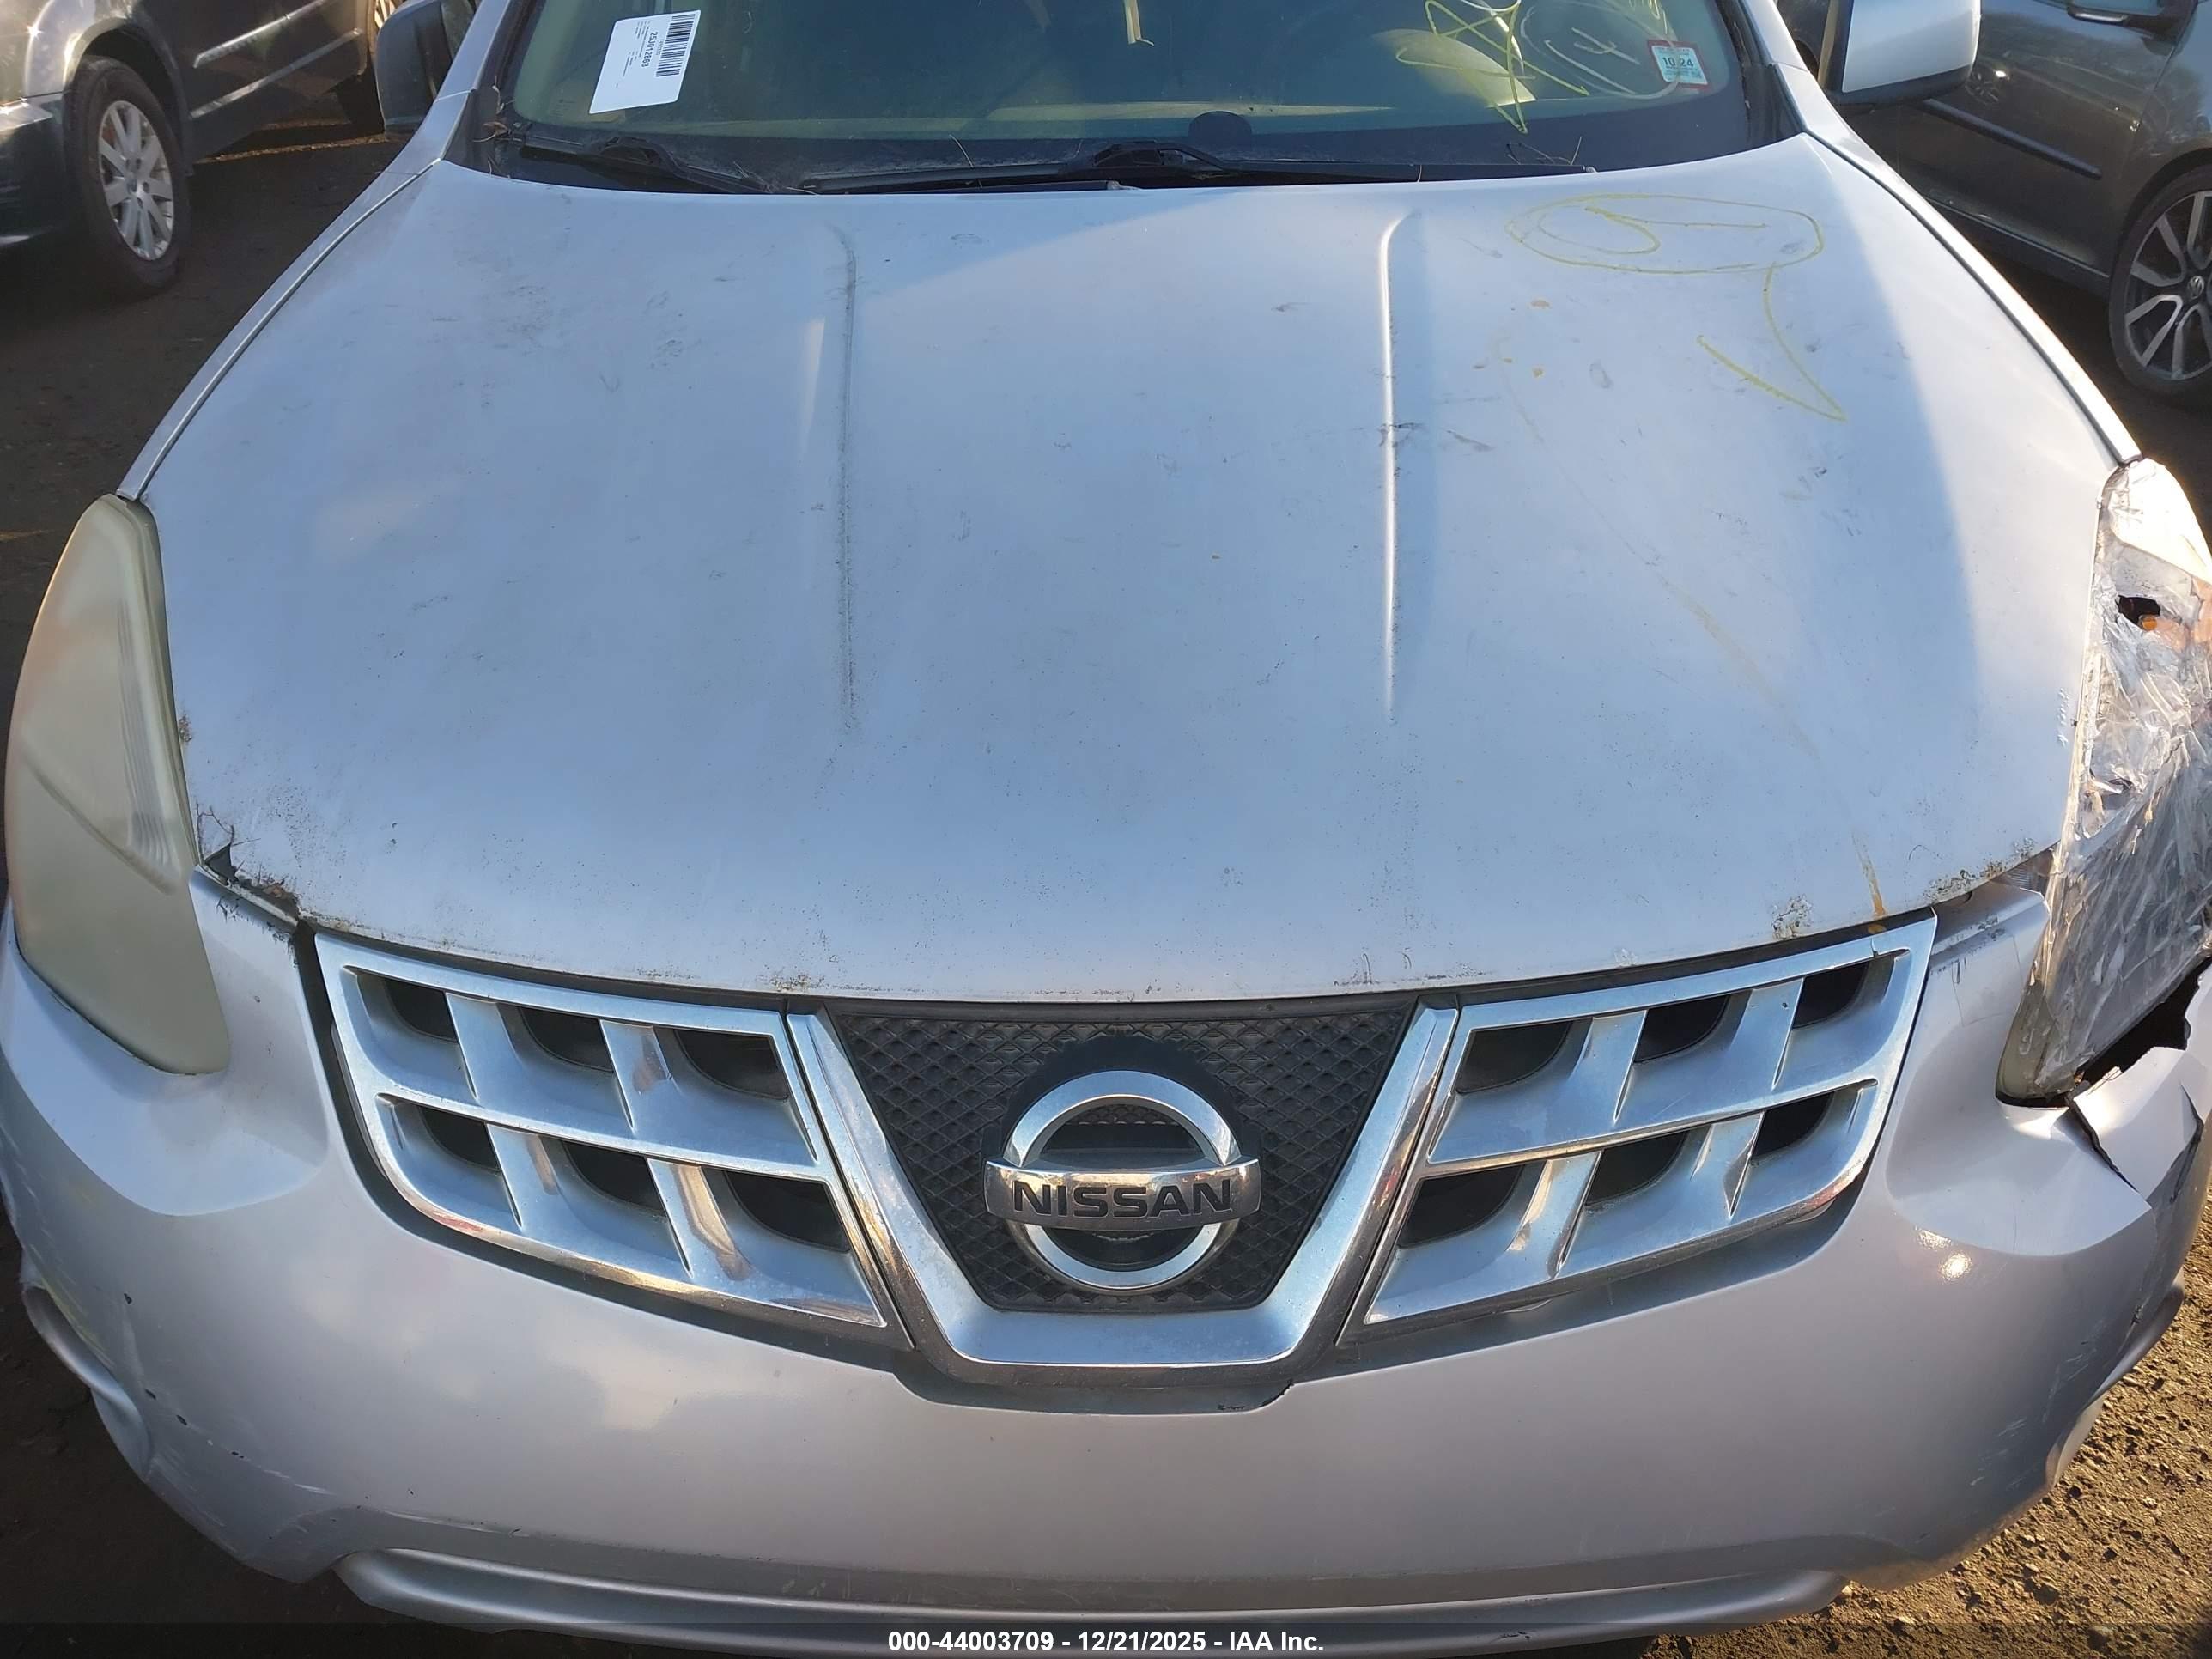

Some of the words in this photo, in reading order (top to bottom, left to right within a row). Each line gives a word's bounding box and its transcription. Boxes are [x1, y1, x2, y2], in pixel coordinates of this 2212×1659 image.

[1662, 57, 1676, 67] 10
[1679, 58, 1694, 67] 24
[1013, 1179, 1230, 1218] NISSAN
